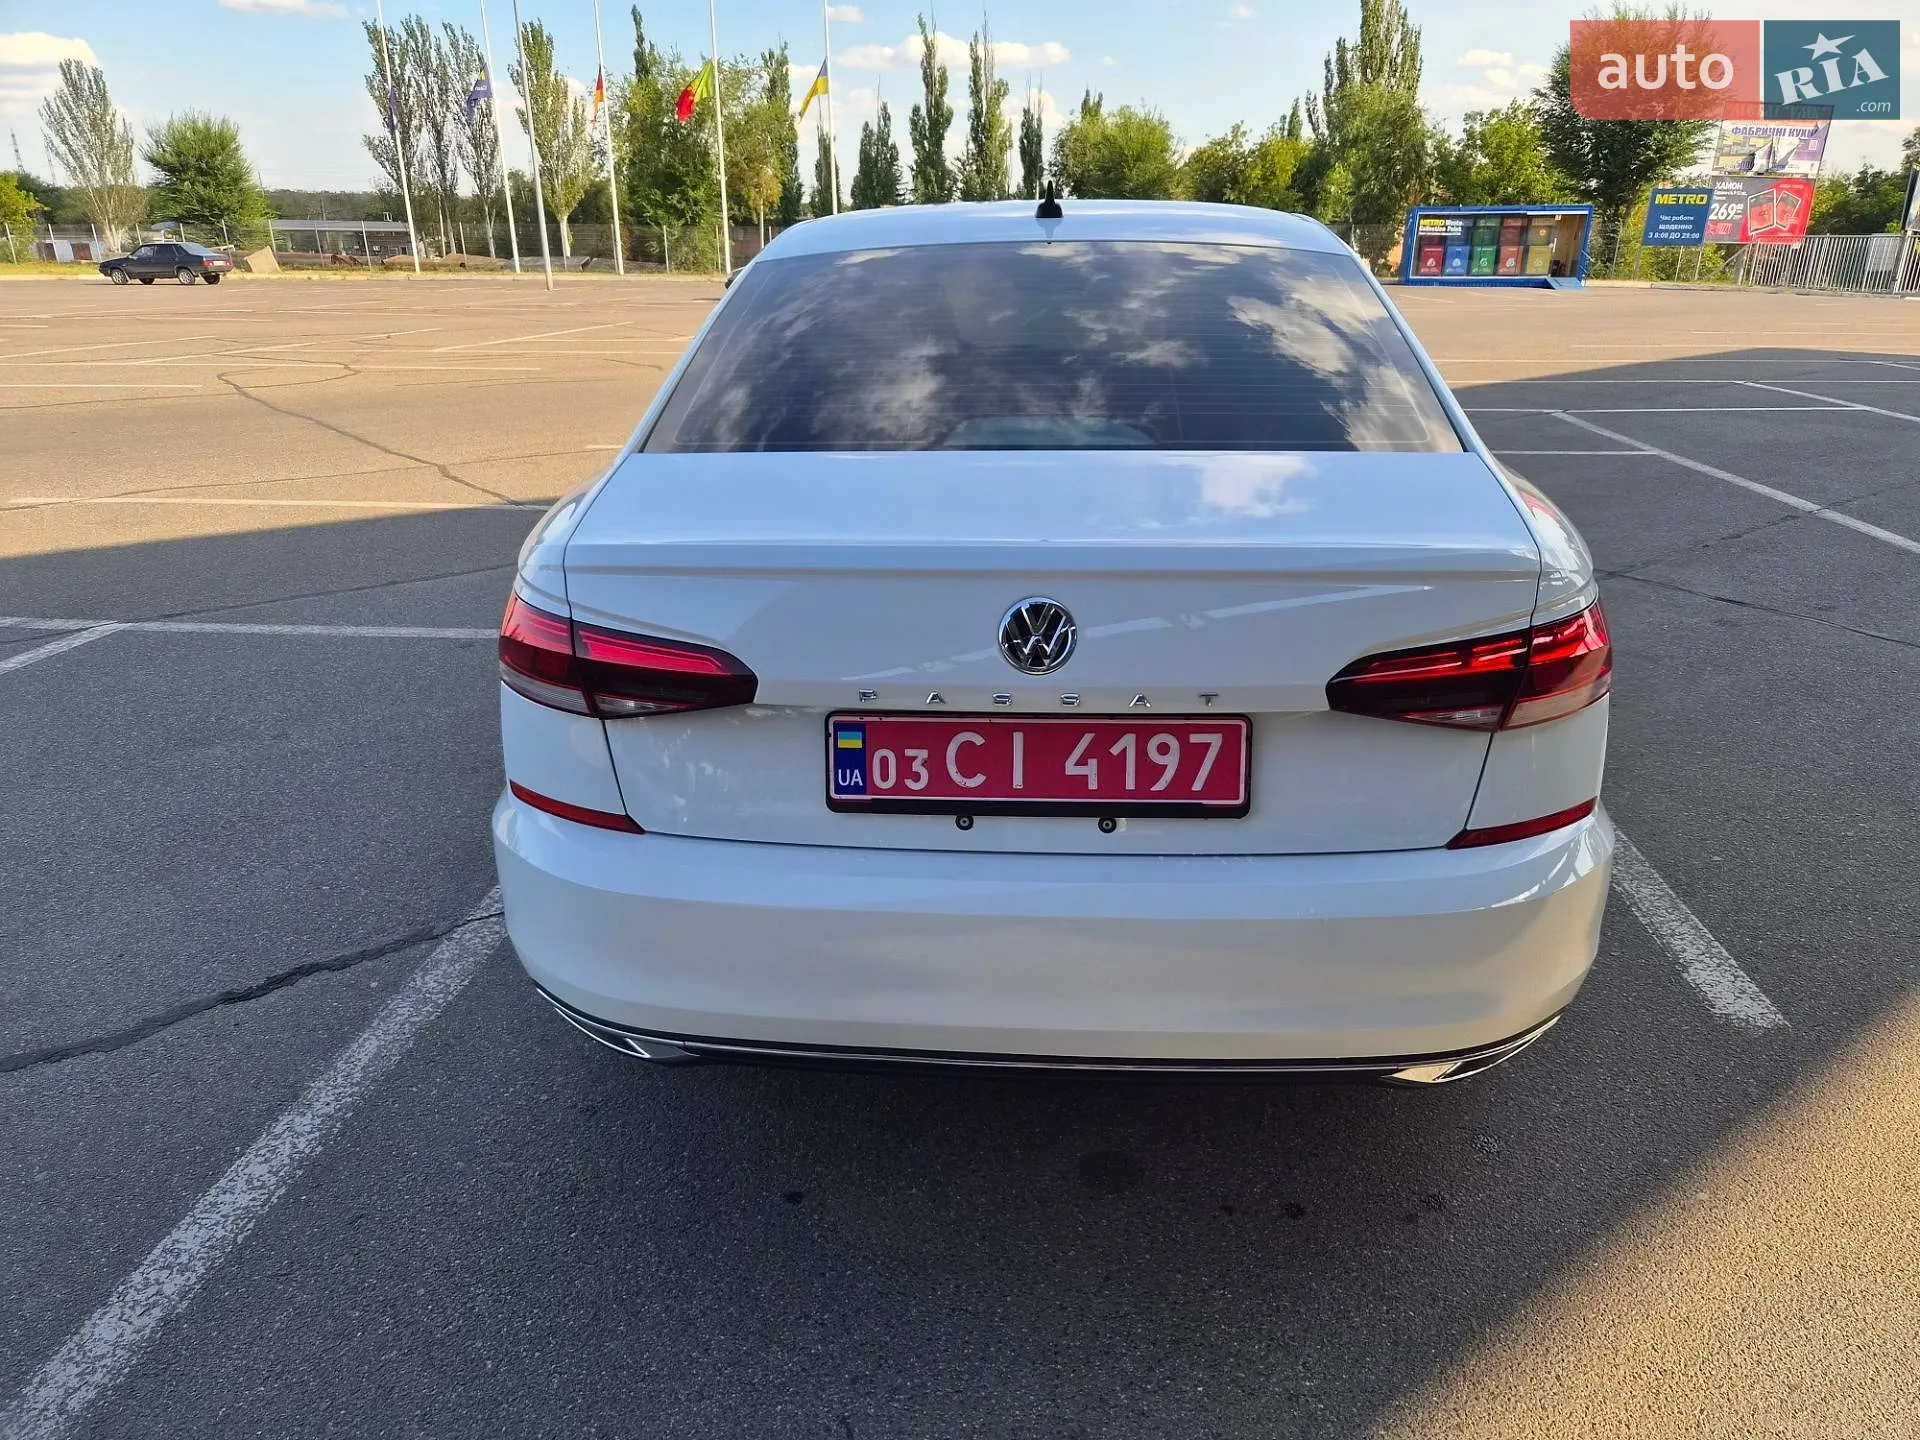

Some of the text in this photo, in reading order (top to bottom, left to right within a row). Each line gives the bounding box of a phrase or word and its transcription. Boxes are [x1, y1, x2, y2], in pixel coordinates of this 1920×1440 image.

[1731, 126, 1787, 137] ФАБРИЧНІ
[1715, 181, 1744, 190] ХАМОН
[1655, 193, 1708, 205] METRO
[1669, 232, 1681, 240] ДО
[858, 689, 1220, 708] PASSAT
[837, 767, 863, 787] UA
[872, 748, 929, 791] 03
[1064, 732, 1223, 792] 4197
